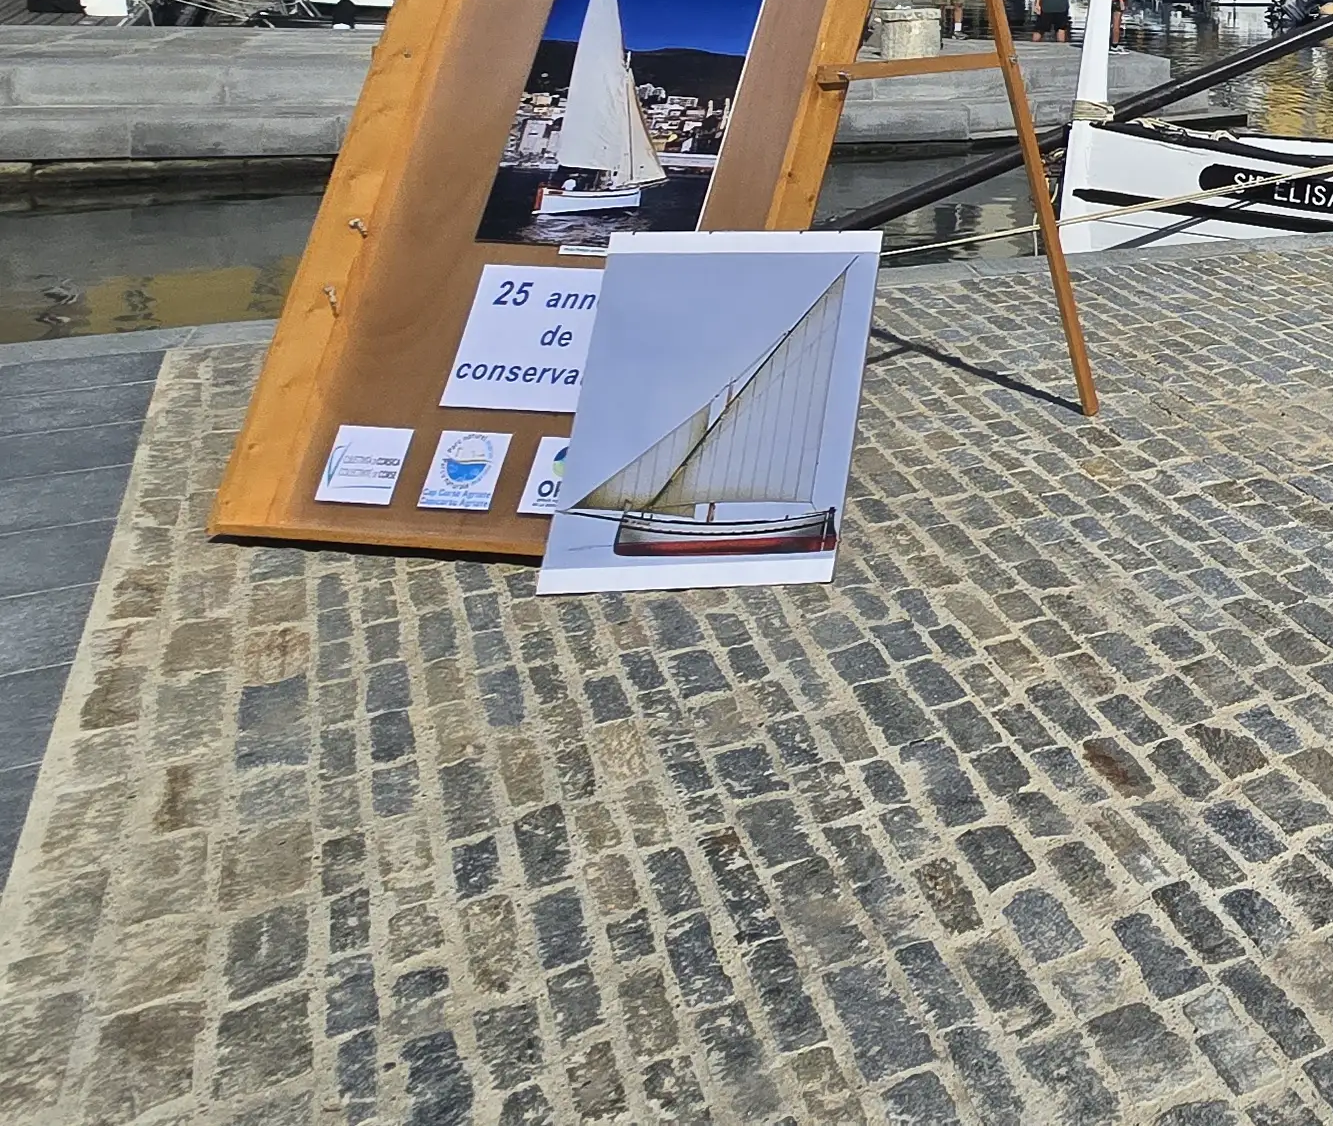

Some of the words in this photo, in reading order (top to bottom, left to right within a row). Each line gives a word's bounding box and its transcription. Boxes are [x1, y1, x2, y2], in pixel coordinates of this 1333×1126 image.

[492, 280, 534, 307] 25
[545, 291, 600, 310] ann
[539, 324, 573, 347] de
[455, 362, 584, 386] conserva
